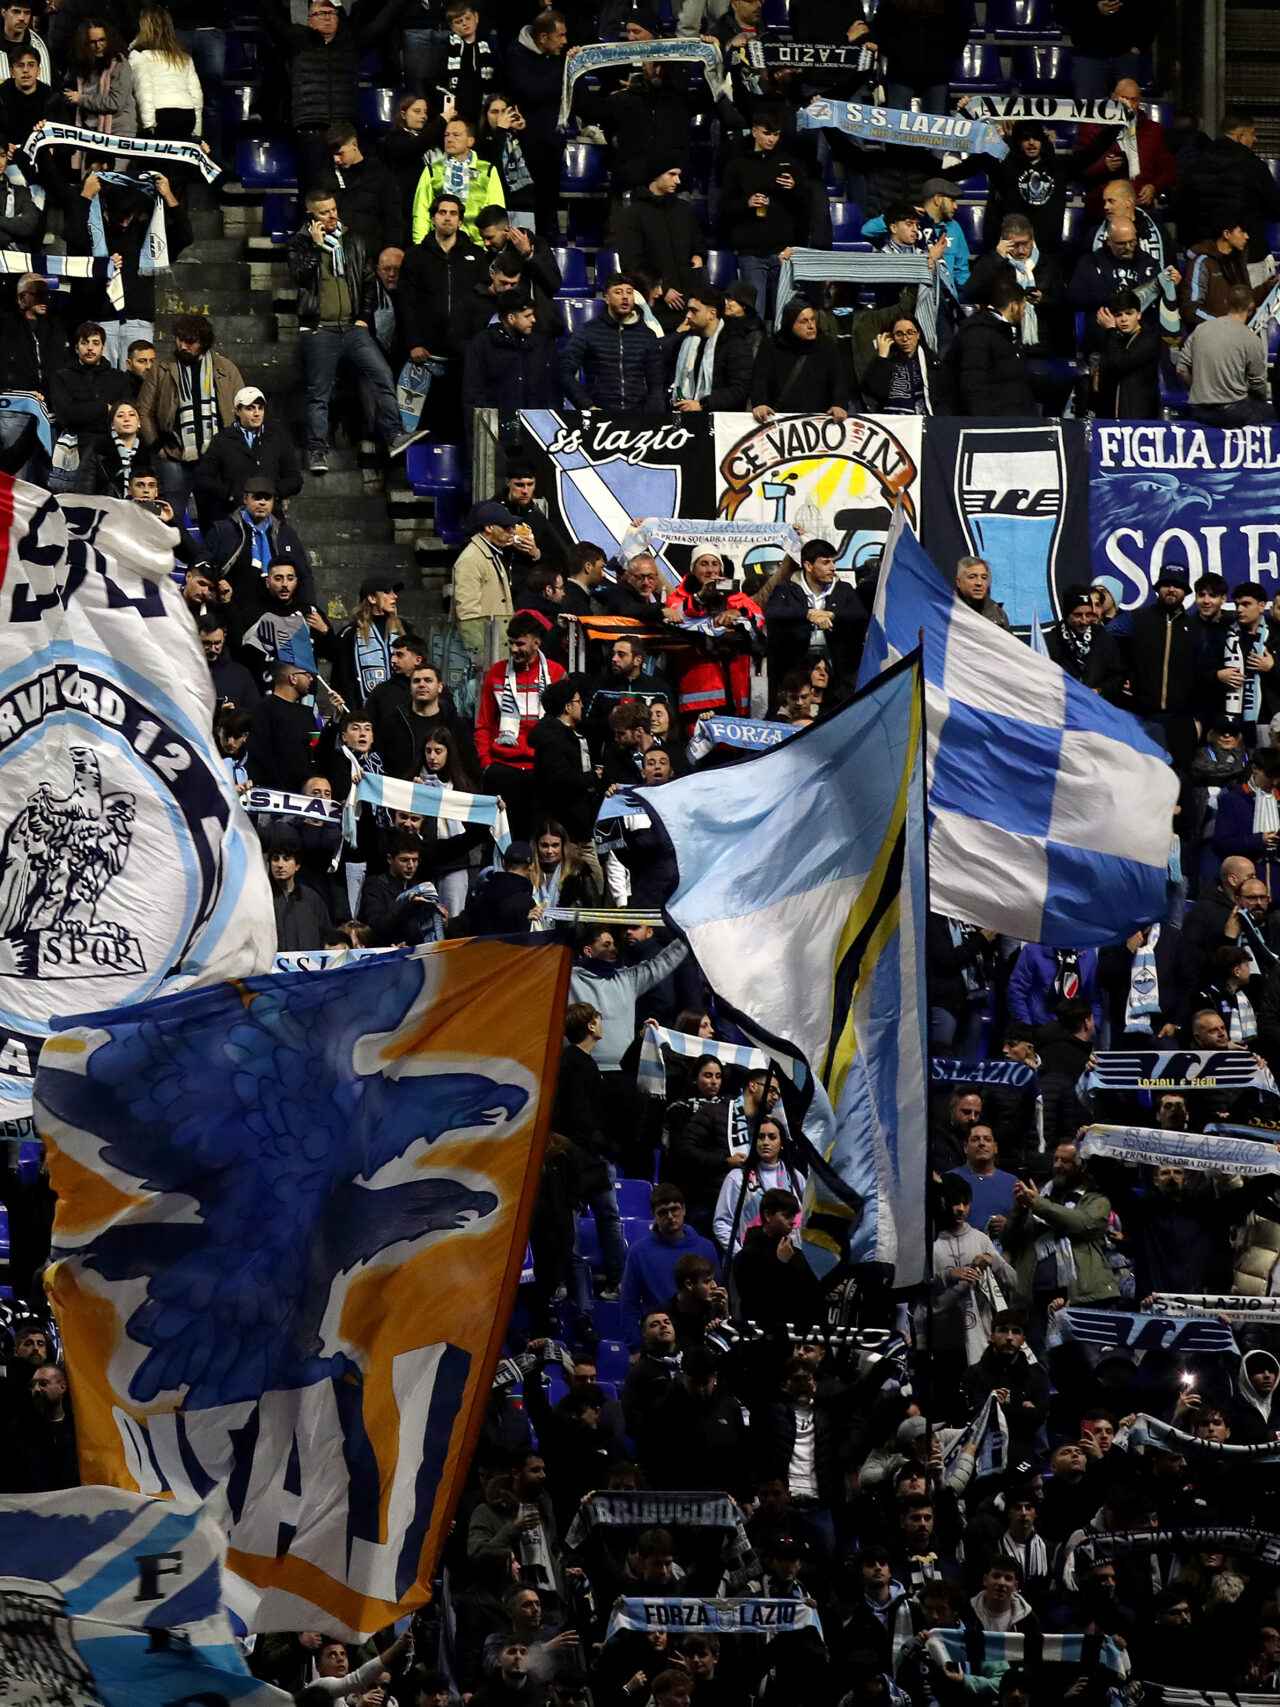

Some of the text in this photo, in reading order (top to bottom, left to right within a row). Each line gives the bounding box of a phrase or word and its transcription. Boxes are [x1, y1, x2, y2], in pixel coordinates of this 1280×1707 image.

[778, 48, 847, 63] LAZIO
[846, 102, 973, 138] S.S. LAZIO
[51, 127, 109, 147] SALVI
[117, 140, 148, 153] GLI
[592, 420, 695, 465] lazio
[727, 415, 907, 480] CE VADO IN
[1097, 425, 1216, 470] FIGLIA
[687, 535, 727, 544] SQUADRA
[58, 669, 126, 725] ORD
[133, 720, 191, 782] 12
[712, 722, 783, 744] FORZA
[283, 793, 343, 819] LAZ
[44, 936, 144, 972] SPQR
[949, 1060, 1035, 1087] LAZIO
[1125, 1150, 1153, 1162] PRIMA
[1154, 1155, 1197, 1168] SQUADRA
[1197, 1160, 1227, 1172] DELLA
[1227, 1164, 1270, 1175] CAPITALE
[1202, 1297, 1262, 1312] LAZIO
[644, 1603, 796, 1626] FORZA LAZIO
